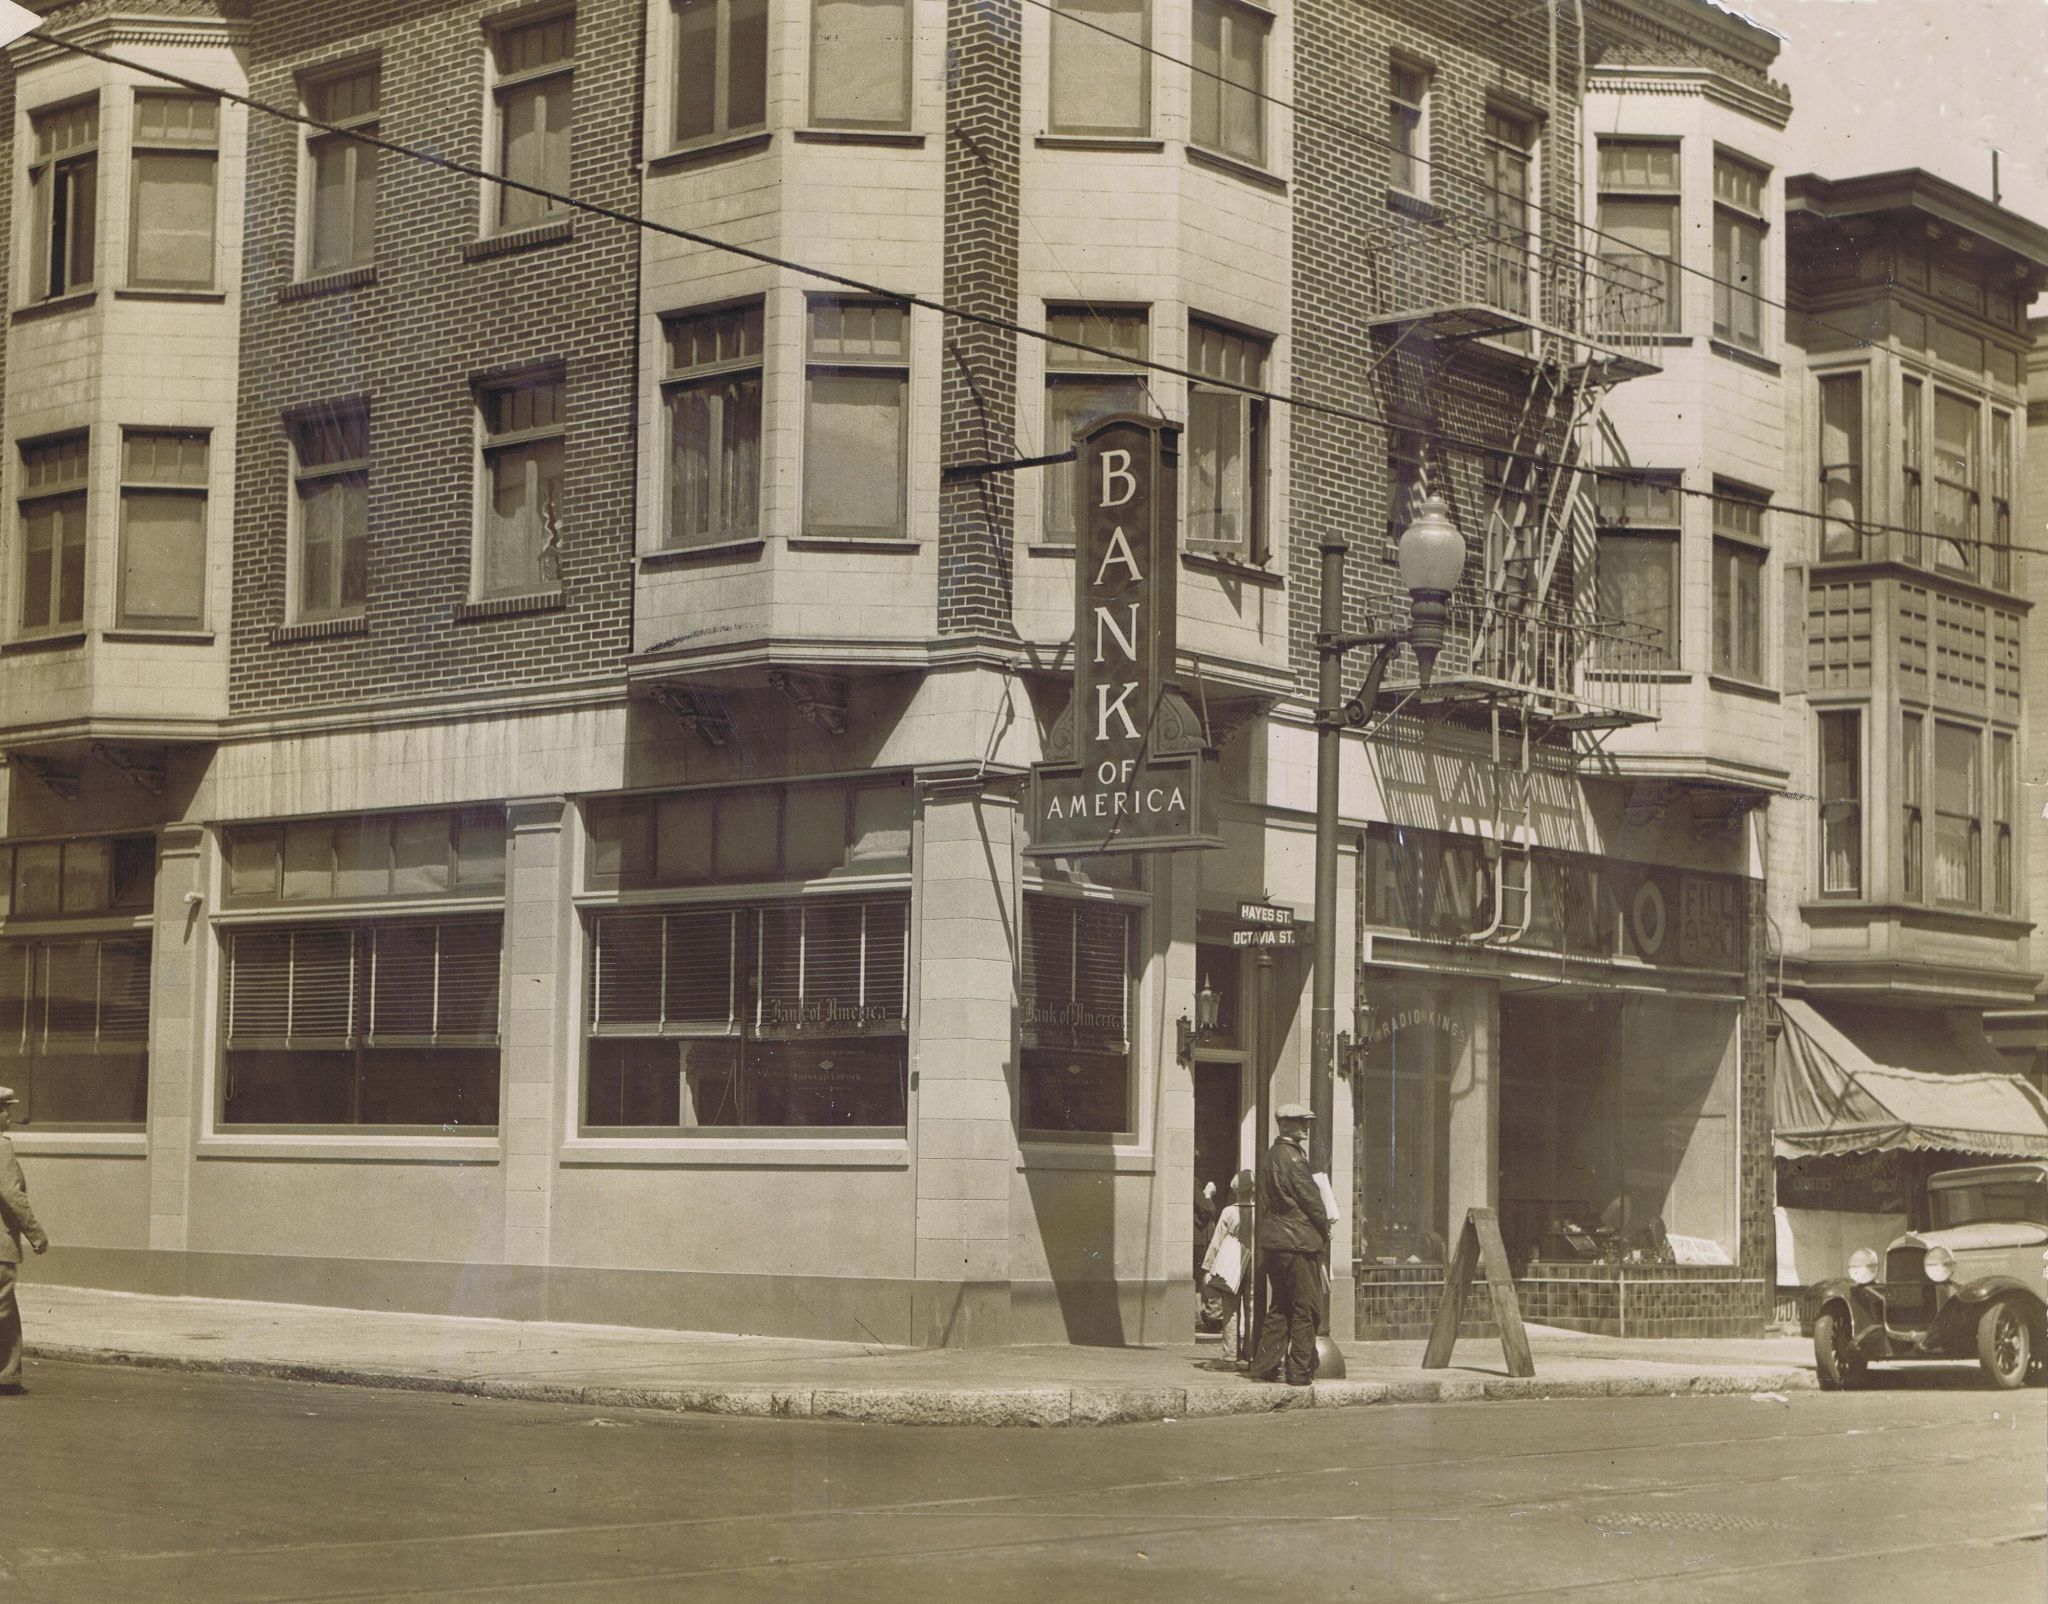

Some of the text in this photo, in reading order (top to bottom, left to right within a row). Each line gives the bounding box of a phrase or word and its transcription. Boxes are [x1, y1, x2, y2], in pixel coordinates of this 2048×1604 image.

[1093, 448, 1144, 741] BANK
[1098, 760, 1136, 785] OF
[1047, 786, 1186, 820] AMERICA
[1241, 904, 1291, 924] HAYES ST.
[1233, 930, 1295, 945] OCTAVIA ST.
[770, 998, 805, 1023] Bank
[824, 997, 887, 1022] America
[1024, 997, 1058, 1023] Bank
[1060, 1002, 1074, 1025] of
[1382, 1008, 1465, 1042] RADIO KINGS
